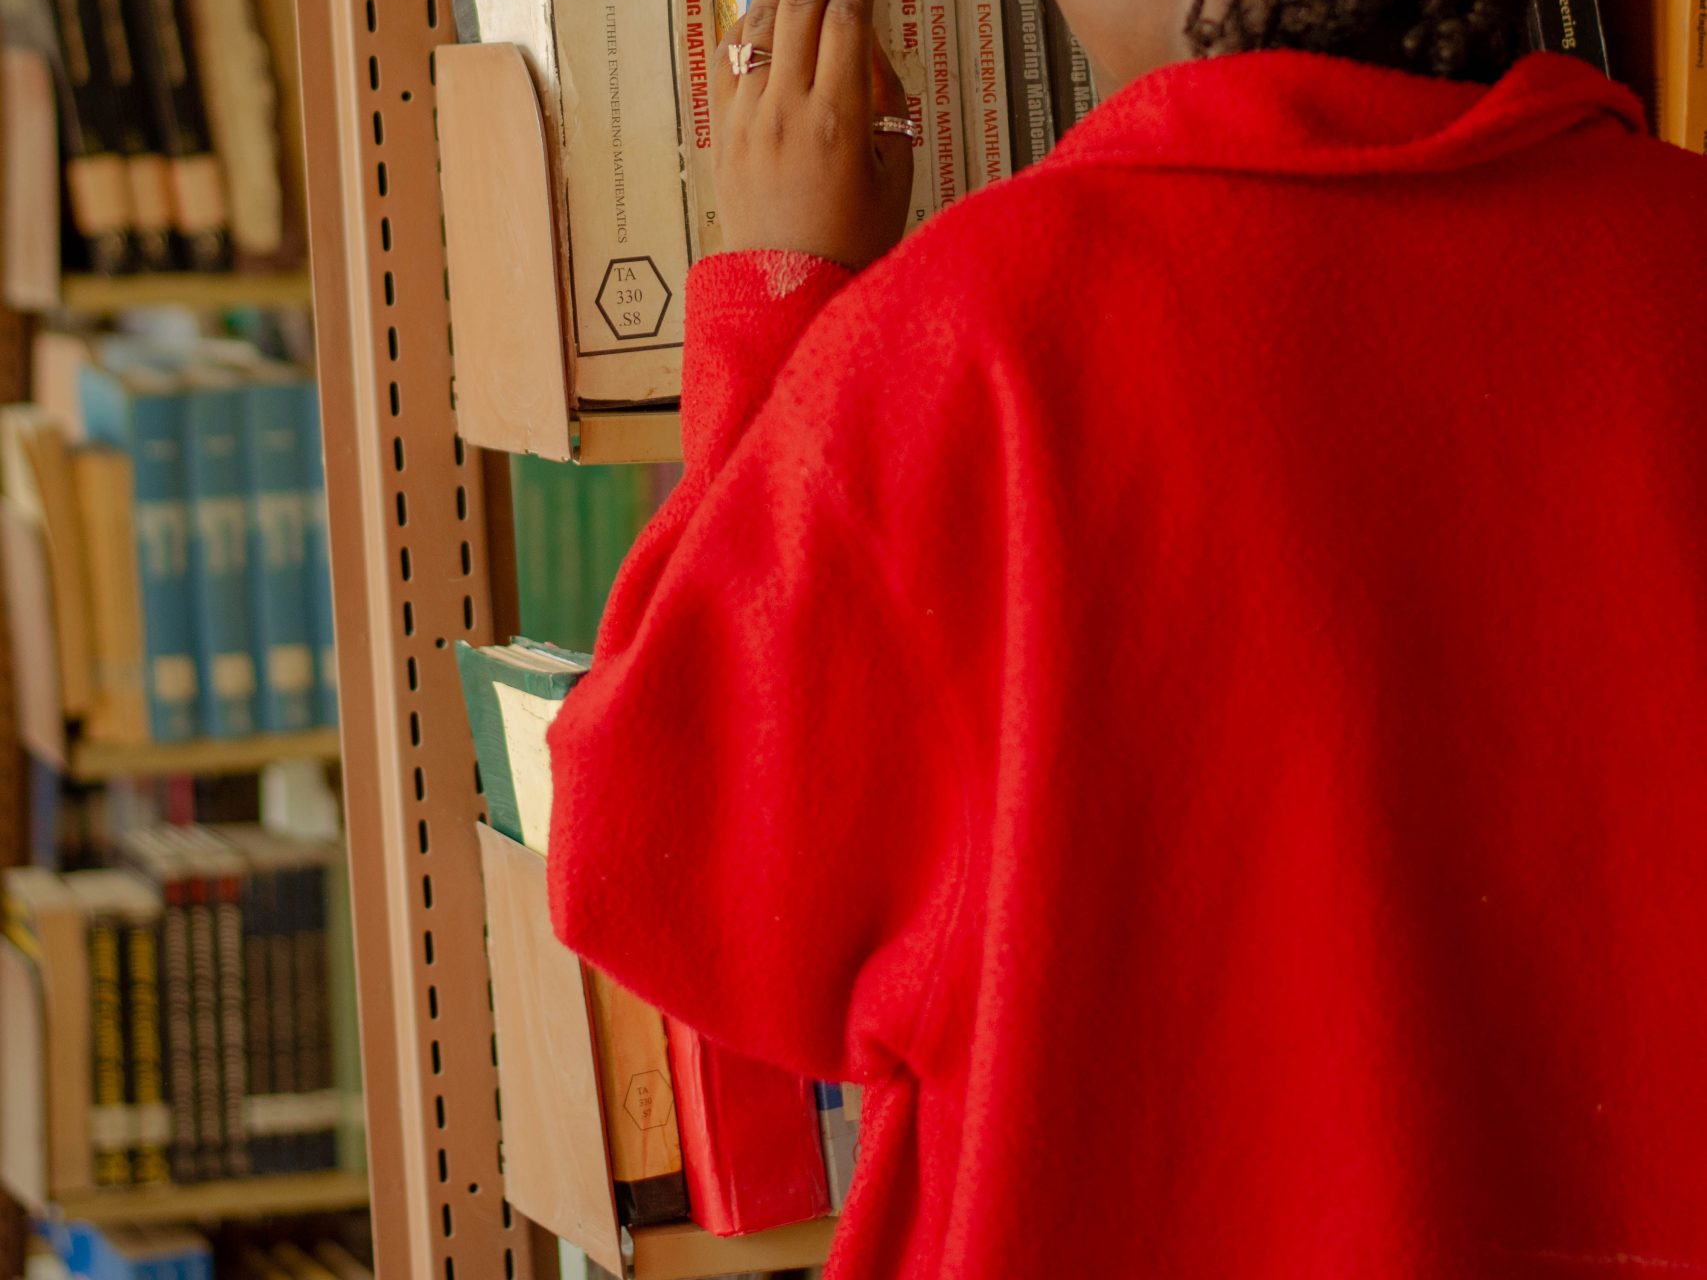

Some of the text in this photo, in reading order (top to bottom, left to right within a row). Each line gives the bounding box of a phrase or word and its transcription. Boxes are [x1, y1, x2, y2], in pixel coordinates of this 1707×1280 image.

[685, 22, 712, 150] MATHEMATICS
[929, 4, 951, 106] ENGINEERING
[977, 2, 998, 104] ENGINEERING
[605, 5, 628, 245] FUTHER ENGINEERING MATHEMATICS
[934, 109, 957, 209] MATHEMATIC
[983, 108, 1002, 183] MATHEMA
[1026, 83, 1049, 165] Mathema
[705, 210, 714, 228] Dr.
[613, 266, 637, 282] TA
[616, 288, 644, 305] 330
[618, 310, 642, 327] .S8
